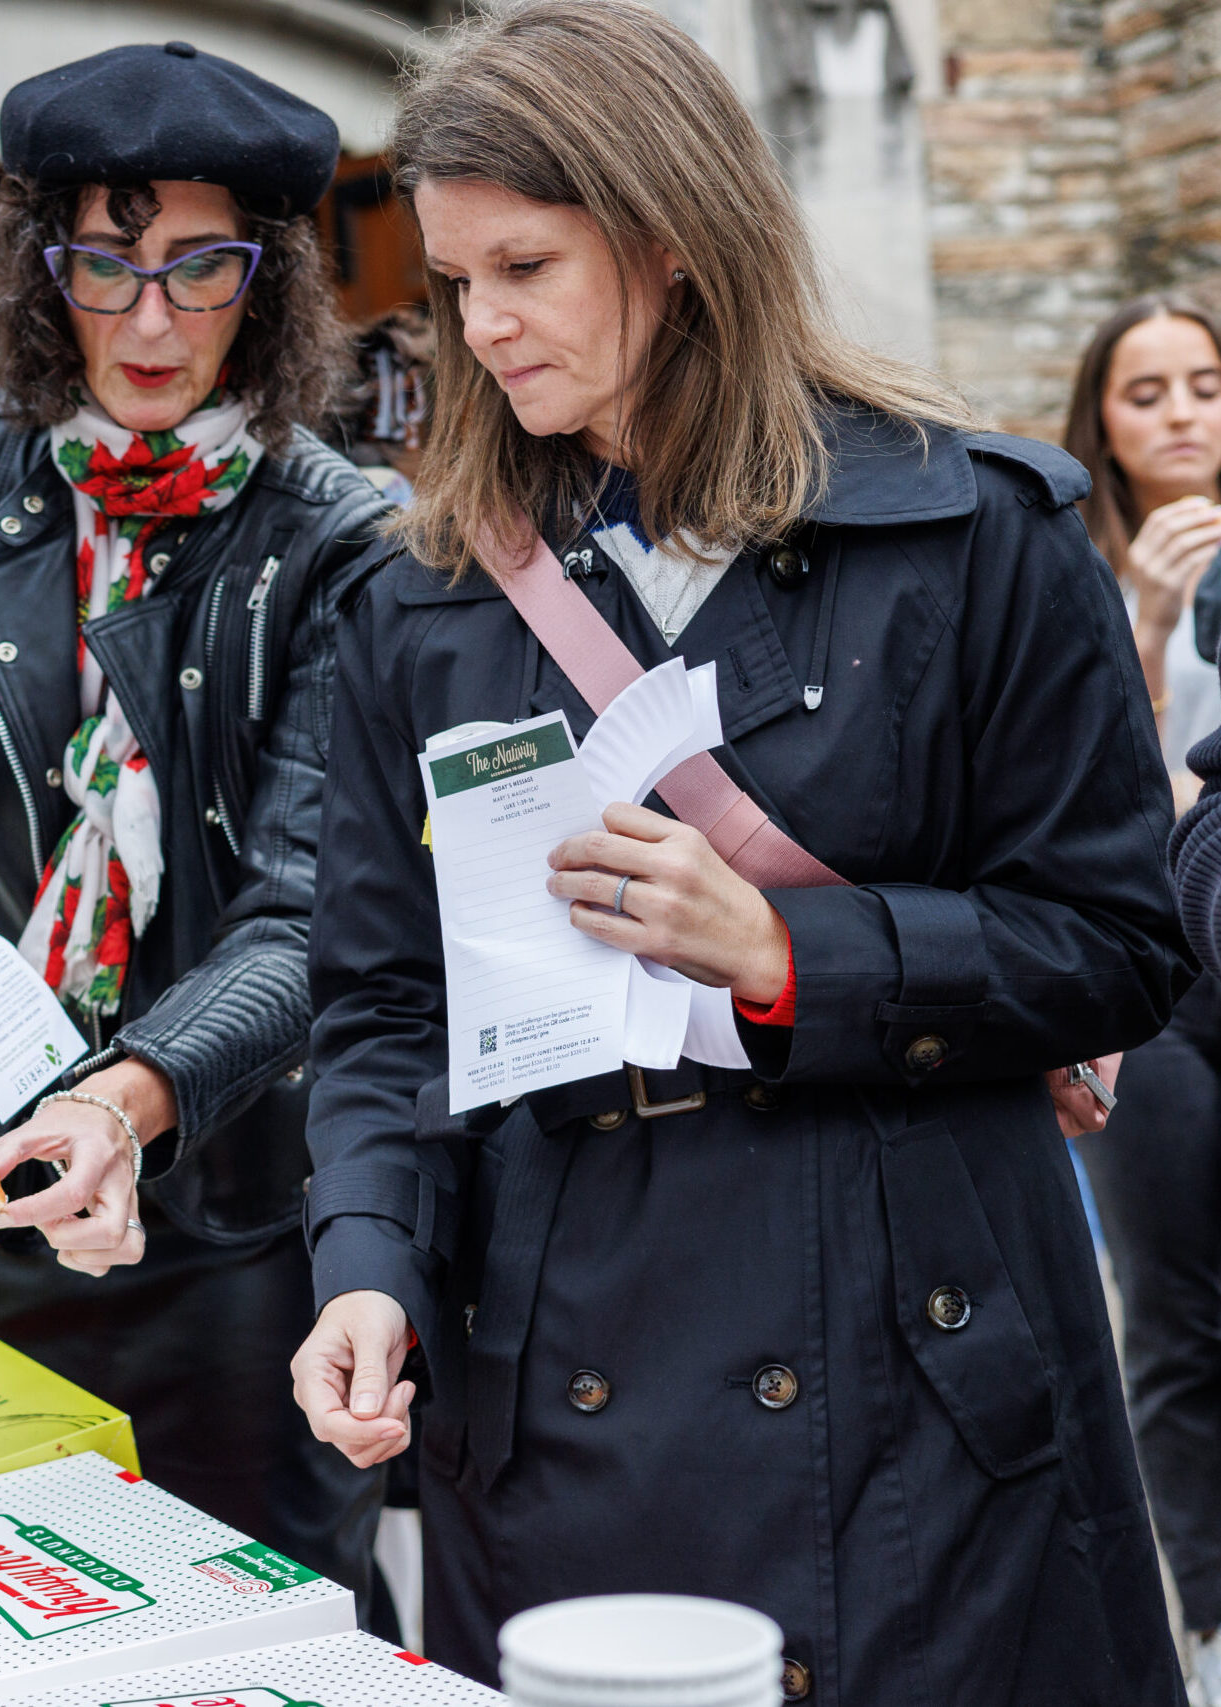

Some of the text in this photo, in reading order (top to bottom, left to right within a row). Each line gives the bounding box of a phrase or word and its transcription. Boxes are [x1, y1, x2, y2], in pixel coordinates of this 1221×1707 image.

[466, 740, 538, 776] The Nativity
[491, 776, 534, 793] TODAY'S MESSAGE
[491, 815, 505, 824] CHAD
[522, 807, 534, 815] LEAD
[534, 802, 551, 812] PASTOR
[503, 802, 516, 811] LUKE
[558, 1010, 570, 1019] given
[577, 1005, 592, 1014] texting
[504, 1030, 516, 1038] GIVE
[558, 1017, 570, 1025] code
[575, 1012, 590, 1020] online
[553, 1042, 579, 1053] THROUGH
[15, 1060, 50, 1095] CHRIST
[467, 1068, 479, 1077] WEEK
[25, 1529, 133, 1588] DOUGHNUTS
[210, 1558, 251, 1581] REWARDS
